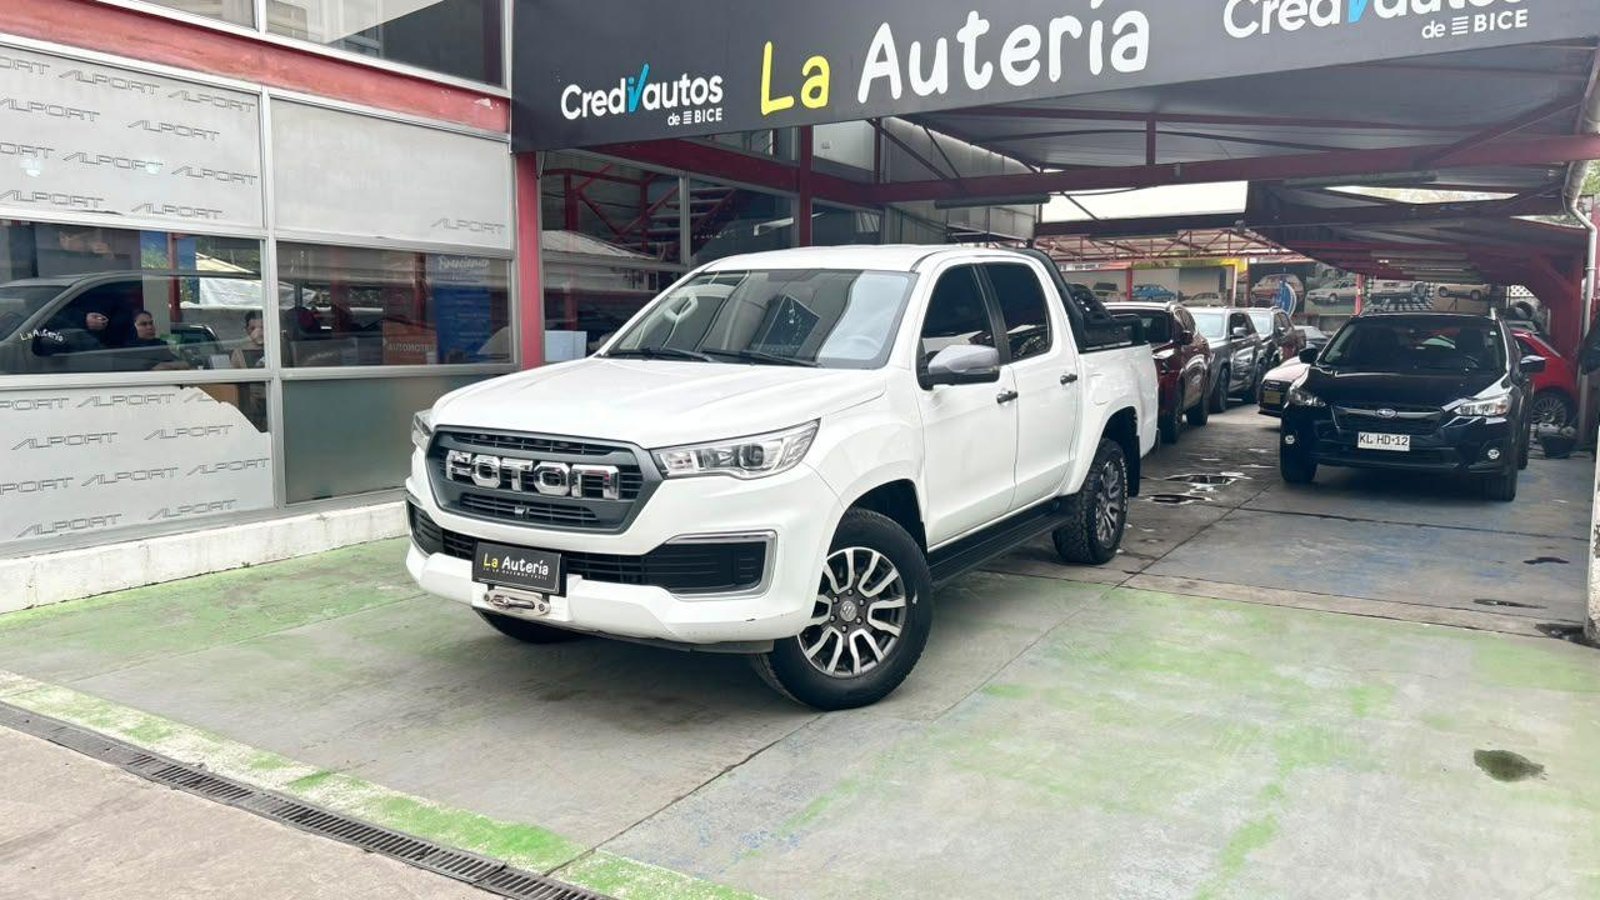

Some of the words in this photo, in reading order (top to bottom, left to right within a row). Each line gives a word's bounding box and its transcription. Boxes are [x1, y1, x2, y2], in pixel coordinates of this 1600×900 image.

[1421, 20, 1446, 39] de
[1474, 9, 1528, 32] BICE
[59, 69, 160, 94] ALPORT
[168, 90, 256, 113] ALPORT
[760, 41, 831, 116] La
[128, 120, 221, 141] ALPORT
[667, 113, 681, 126] de
[694, 108, 723, 124] BICE
[172, 166, 258, 185] ALPORT
[0, 189, 104, 208] ALPORT
[131, 203, 223, 220] ALPORT
[77, 393, 176, 409] ALPORT
[11, 431, 119, 451] ALPORT
[144, 424, 234, 441] ALPORT
[81, 467, 179, 487] ALPORT
[187, 457, 270, 477] ALPORT
[445, 449, 620, 500] FOTON
[16, 513, 122, 538] ALPORT
[148, 499, 237, 521] ALPORT
[483, 553, 499, 568] La
[502, 555, 549, 576] Autería
